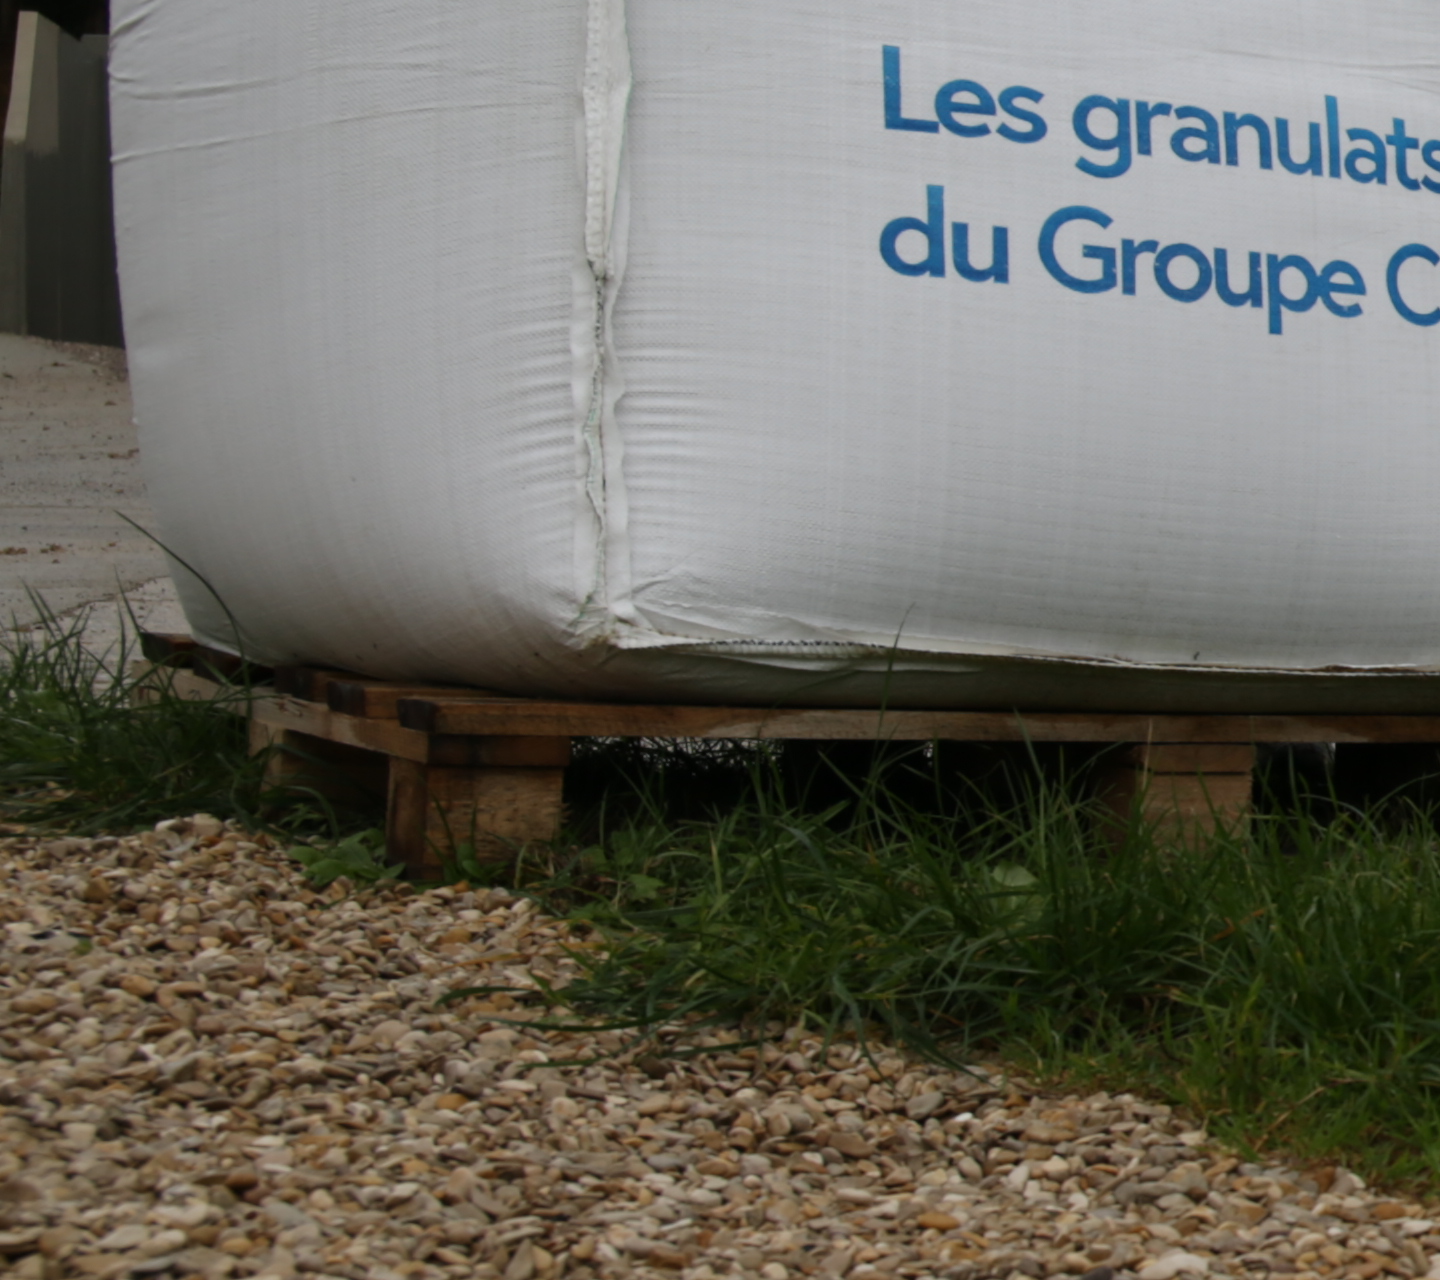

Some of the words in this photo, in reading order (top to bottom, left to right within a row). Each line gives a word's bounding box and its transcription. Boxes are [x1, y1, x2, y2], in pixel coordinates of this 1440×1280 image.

[881, 44, 1047, 145] Les
[878, 183, 1009, 285] du
[1036, 203, 1366, 335] Groupe
